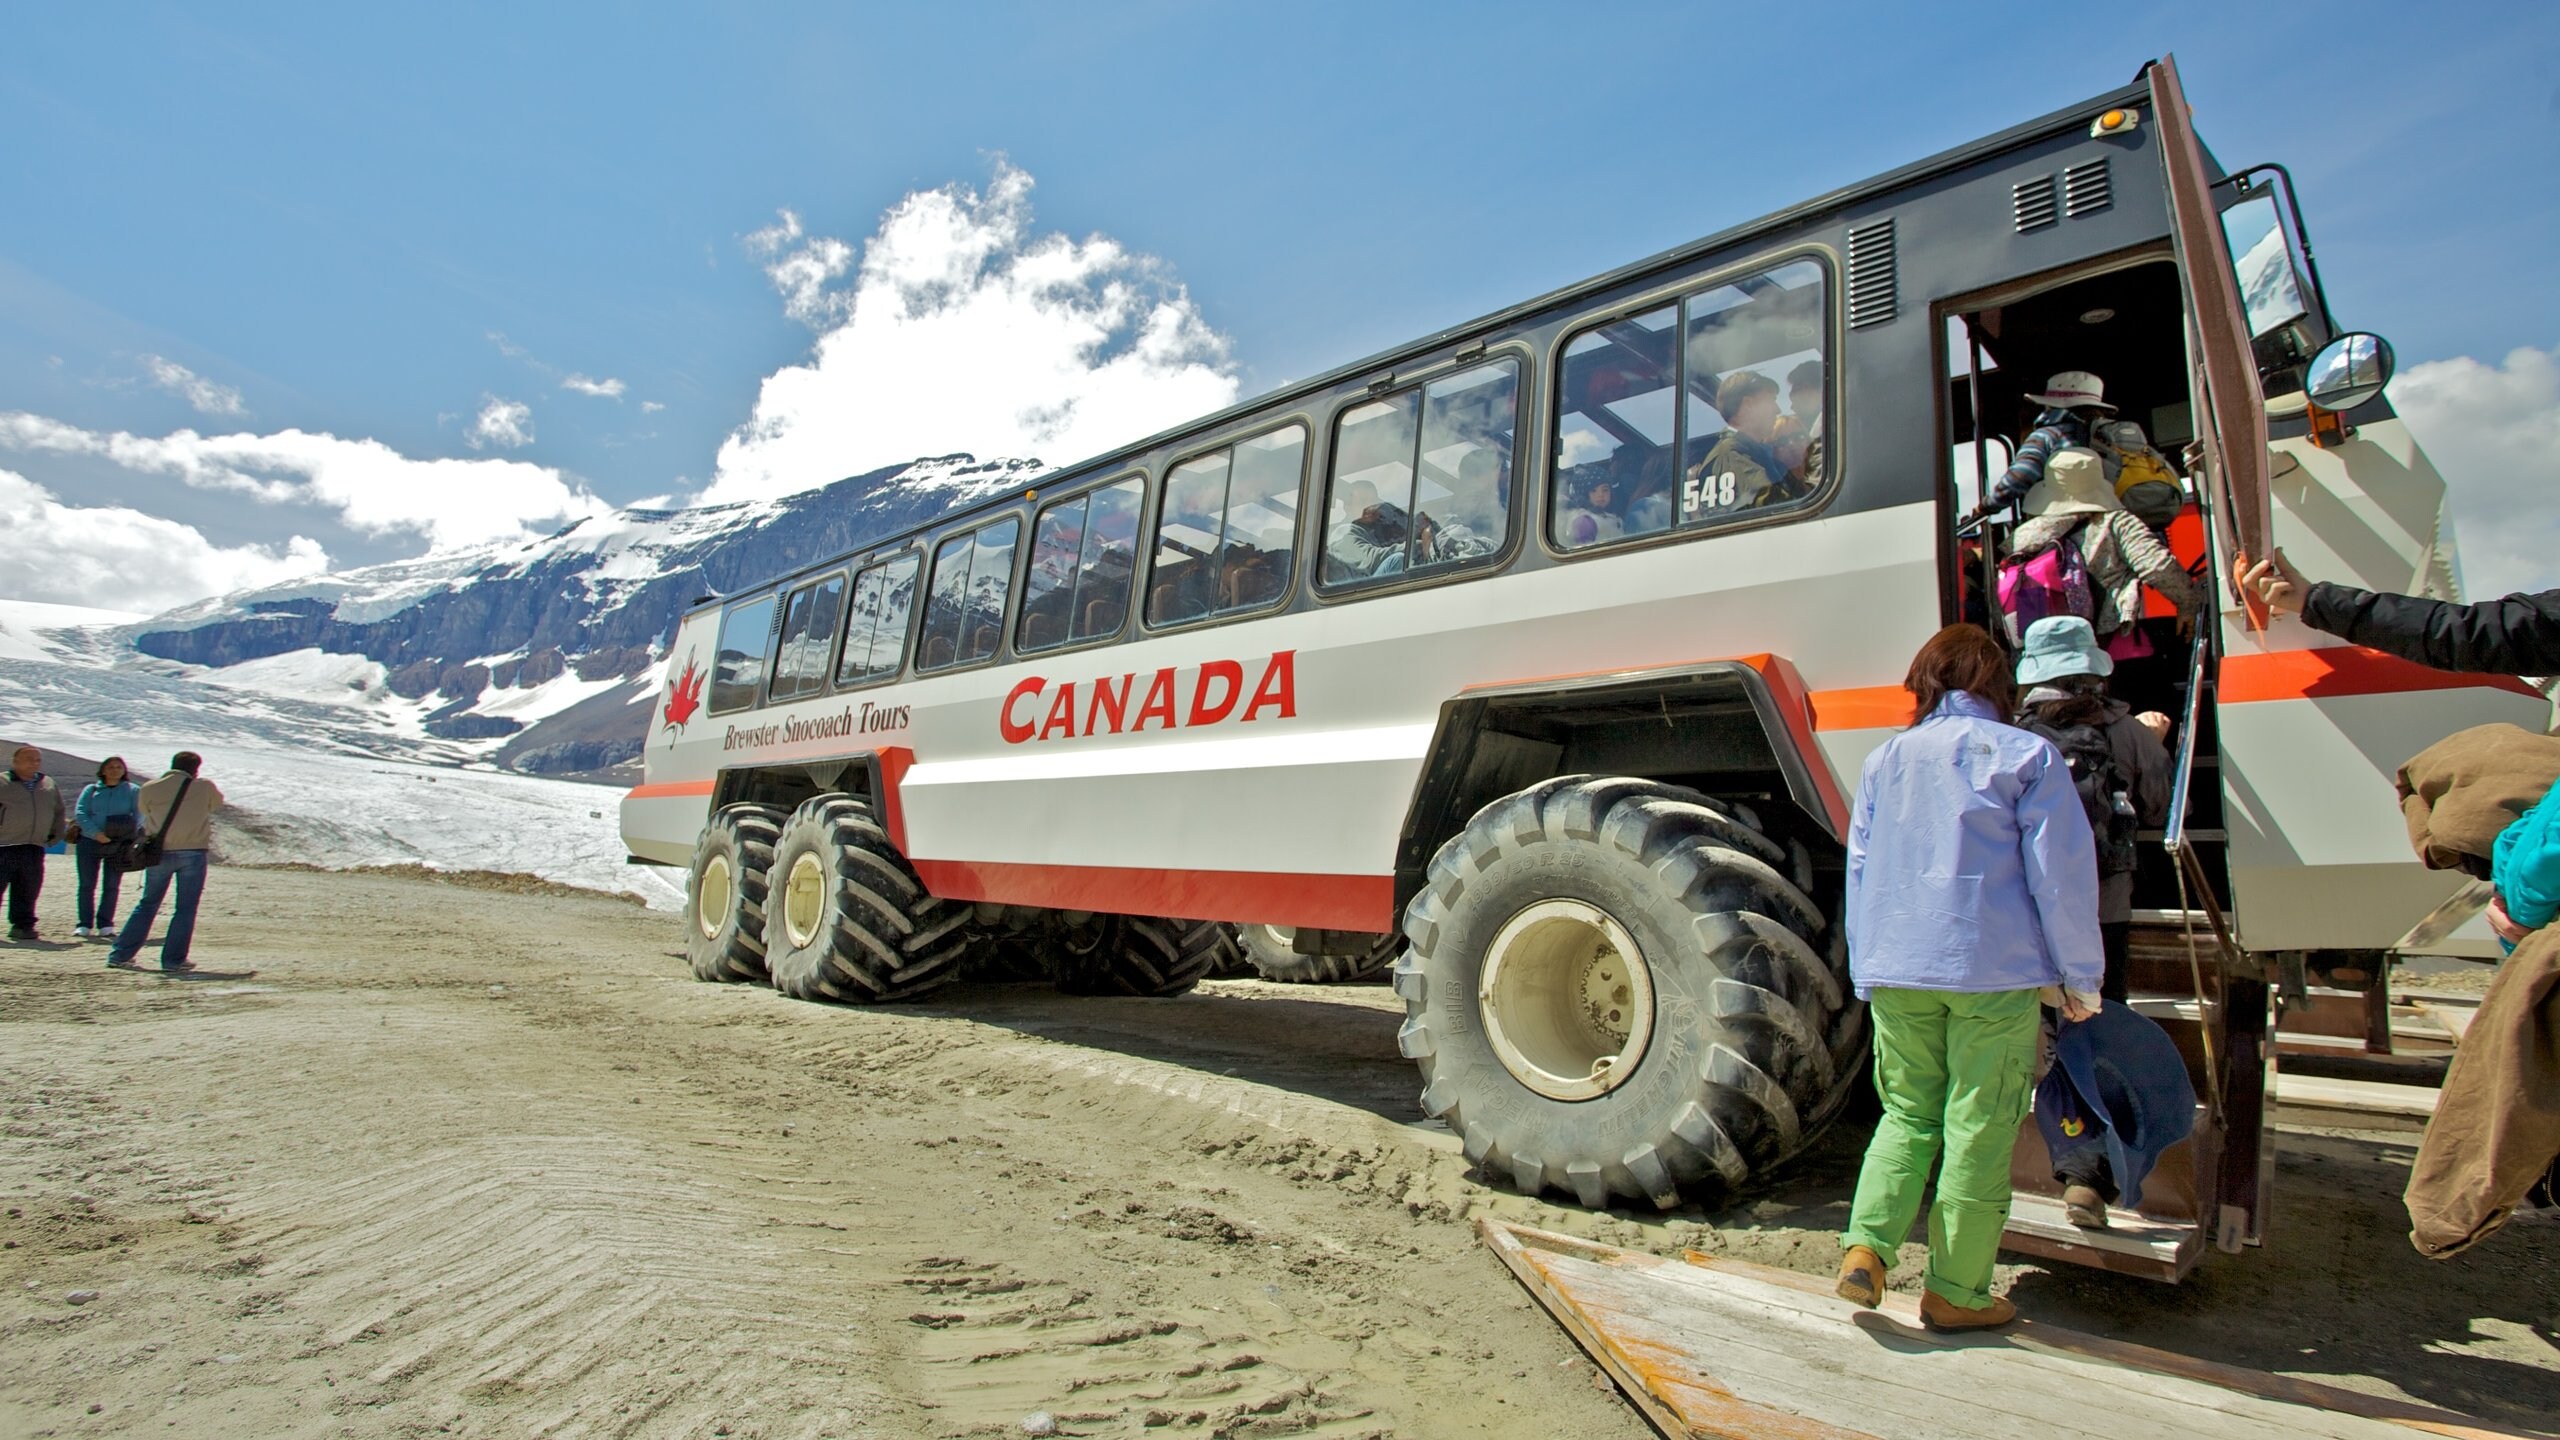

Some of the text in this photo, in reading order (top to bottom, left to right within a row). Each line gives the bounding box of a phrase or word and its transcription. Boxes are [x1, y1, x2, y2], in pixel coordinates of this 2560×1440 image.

[1683, 472, 1736, 513] 548
[1000, 650, 1297, 744] CANADA
[723, 701, 911, 751] Brewster Snocoach Tours
